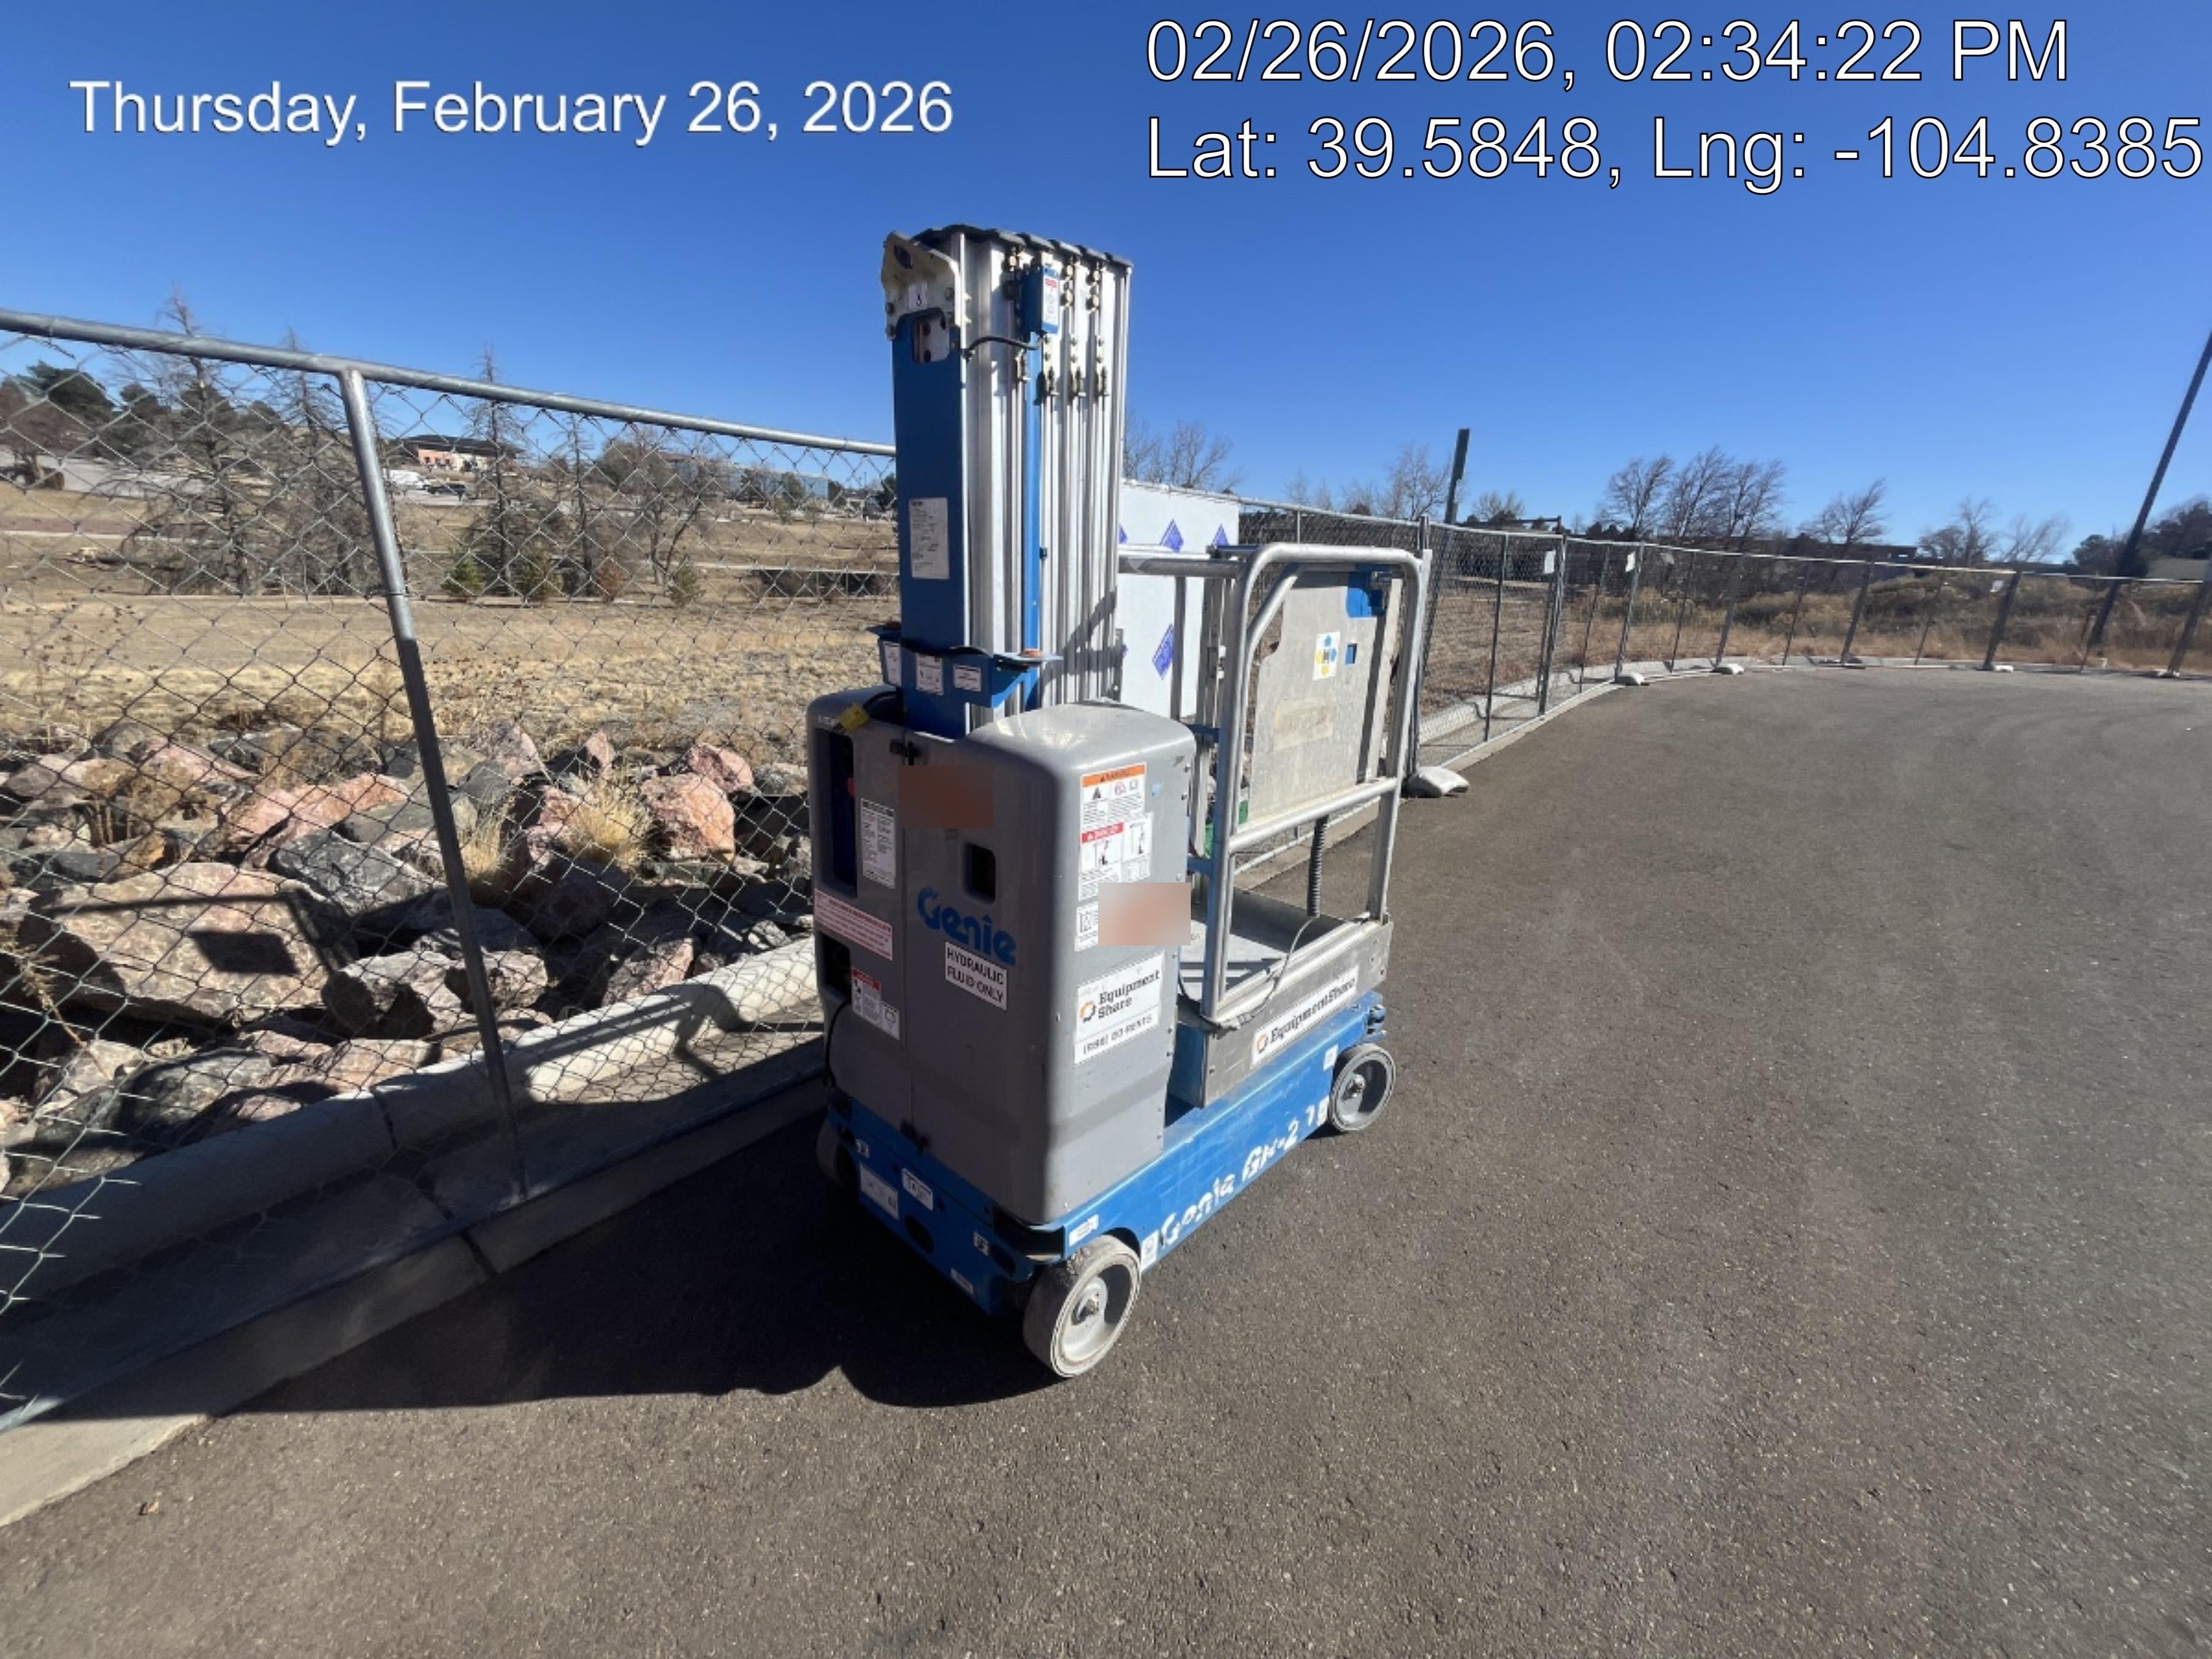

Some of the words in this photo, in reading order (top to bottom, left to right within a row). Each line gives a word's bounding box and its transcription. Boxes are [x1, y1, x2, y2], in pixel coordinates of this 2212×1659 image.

[917, 886, 1017, 967] Genie
[947, 946, 1004, 986] HYDRAULIC
[947, 965, 975, 989] FLUID
[976, 980, 1004, 1003] ONLY
[1099, 969, 1160, 1006] Equipment
[1097, 997, 1133, 1019] Share
[1269, 976, 1356, 1045] EquipmentShare
[1161, 1173, 1236, 1250] Genie
